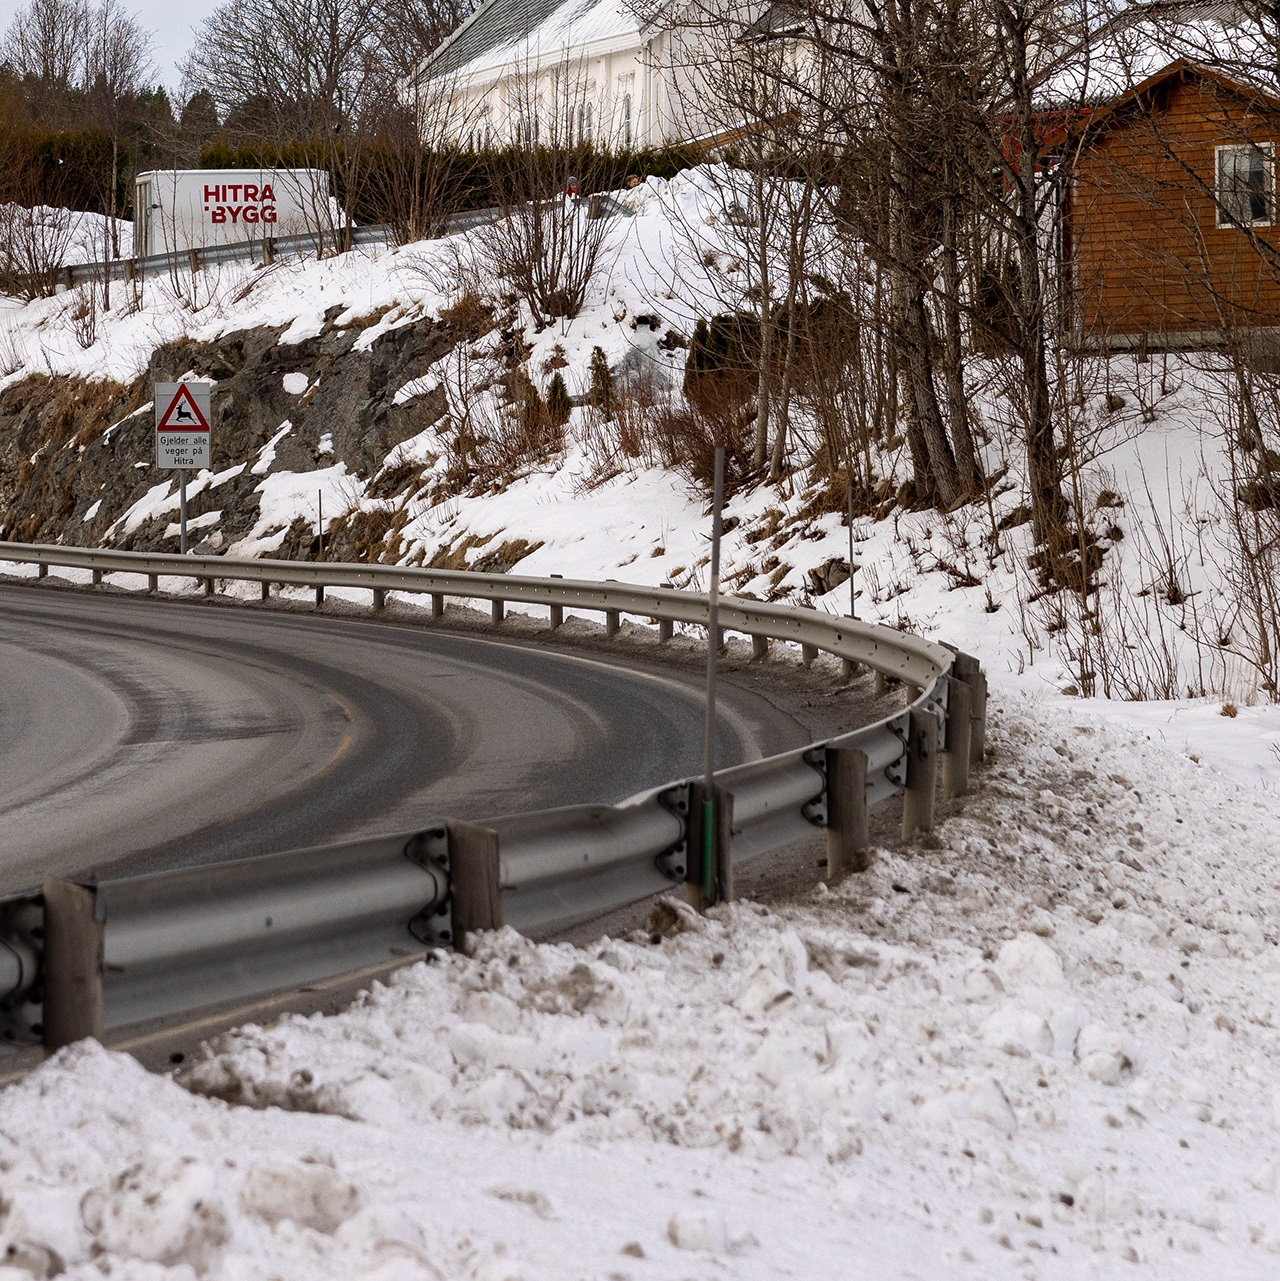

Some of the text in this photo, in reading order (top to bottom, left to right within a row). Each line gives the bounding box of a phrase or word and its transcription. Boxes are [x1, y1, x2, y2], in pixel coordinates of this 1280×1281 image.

[204, 184, 277, 202] HITRA
[211, 205, 277, 223] BYGG
[160, 436, 207, 446] Gjelder alle
[165, 446, 203, 456] veger på
[173, 457, 194, 465] Hitra
